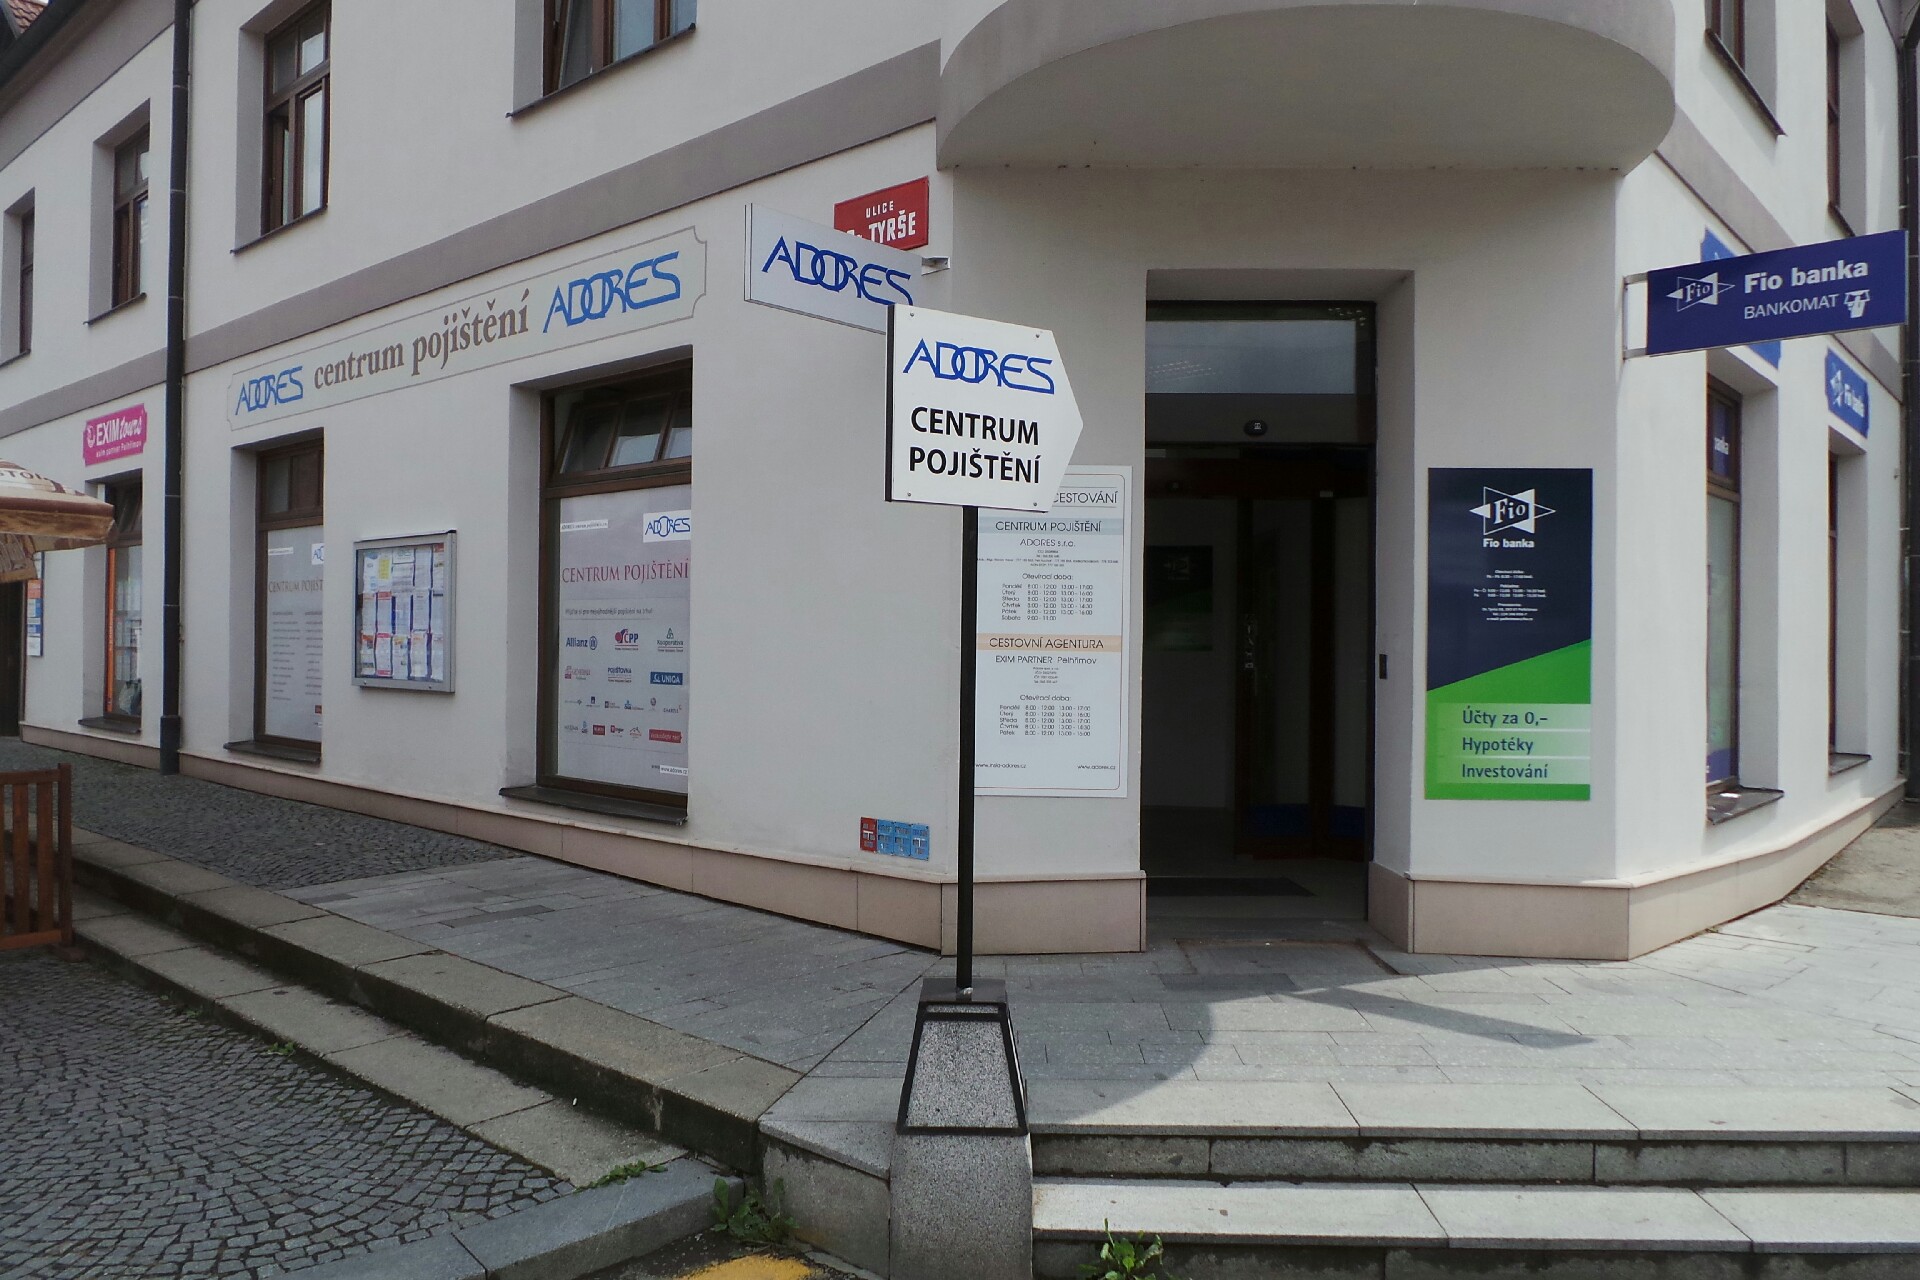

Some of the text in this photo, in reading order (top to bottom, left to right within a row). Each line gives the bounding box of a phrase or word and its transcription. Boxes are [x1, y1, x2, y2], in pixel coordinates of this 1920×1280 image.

[866, 200, 894, 218] ULICE
[868, 210, 916, 244] TYRŠE
[761, 235, 914, 306] ADORES
[1685, 259, 1869, 303] Fio Fio banka
[1744, 293, 1840, 320] BANKOMAT
[234, 250, 681, 416] ADORES centrum pojištění ADORES
[902, 338, 1055, 395] ADORES
[910, 406, 1039, 446] CENTRUM
[909, 446, 1042, 484] POJIŠTĚNÍ
[1493, 498, 1526, 524] Fio
[644, 515, 691, 537] ADORES
[995, 520, 1102, 532] CENTRUM POJIŠTĚNÍ
[1020, 538, 1056, 547] ADORES
[1483, 538, 1535, 548] Fio banka
[562, 558, 689, 583] CENTRUM POJIŠTĚNÍ
[1022, 572, 1052, 580] Otevírací
[565, 637, 588, 648] Allianz
[623, 631, 639, 644] ČPP
[989, 636, 1104, 649] CESTOVNÍ AGENTURA
[995, 655, 1097, 665] EXIM PARTNER Pelhřimov
[1462, 705, 1497, 728] Účty
[1502, 714, 1518, 725] za
[1462, 736, 1534, 755] Hypotéky
[1462, 763, 1549, 779] Investování
